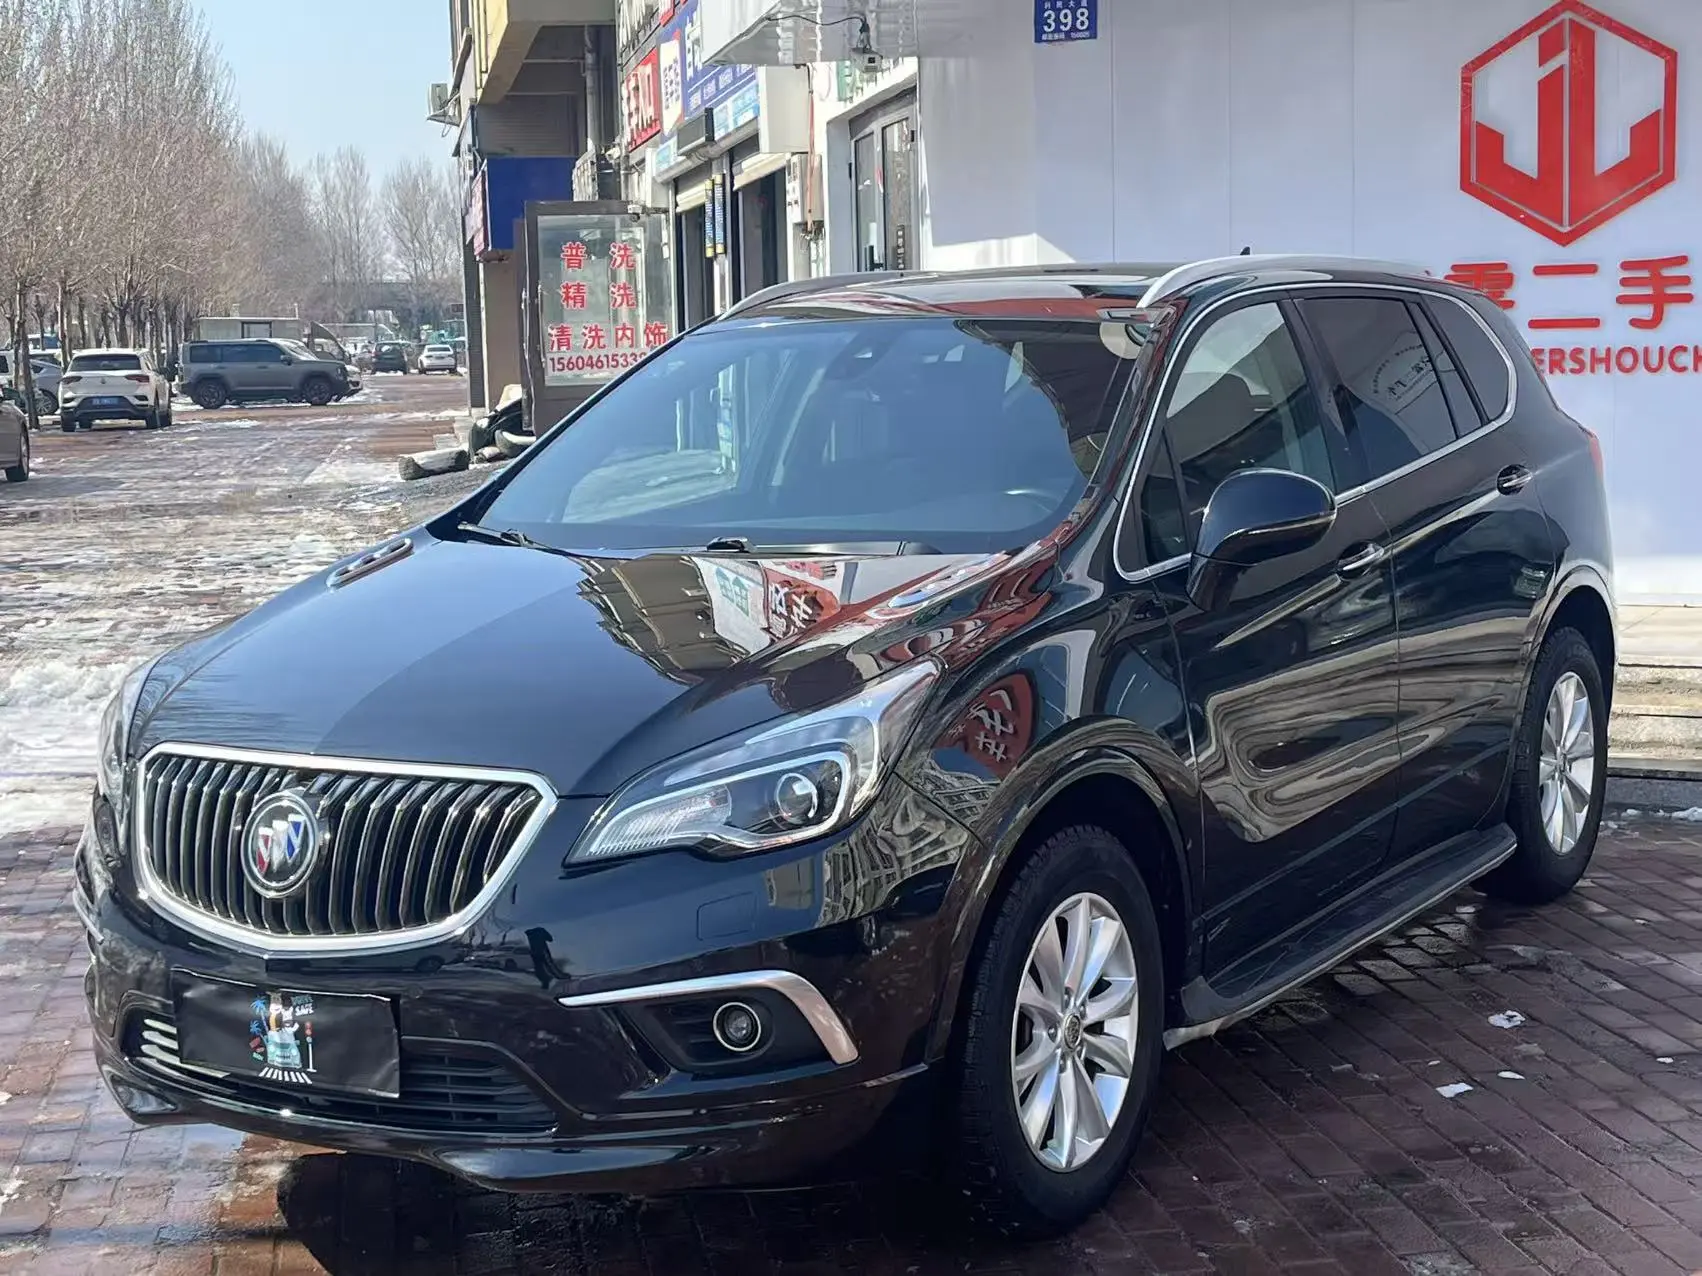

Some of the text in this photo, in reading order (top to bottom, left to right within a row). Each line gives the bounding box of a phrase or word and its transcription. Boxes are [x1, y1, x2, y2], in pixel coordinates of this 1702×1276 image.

[1043, 8, 1089, 32] 398
[547, 322, 668, 352] 清洗内饰
